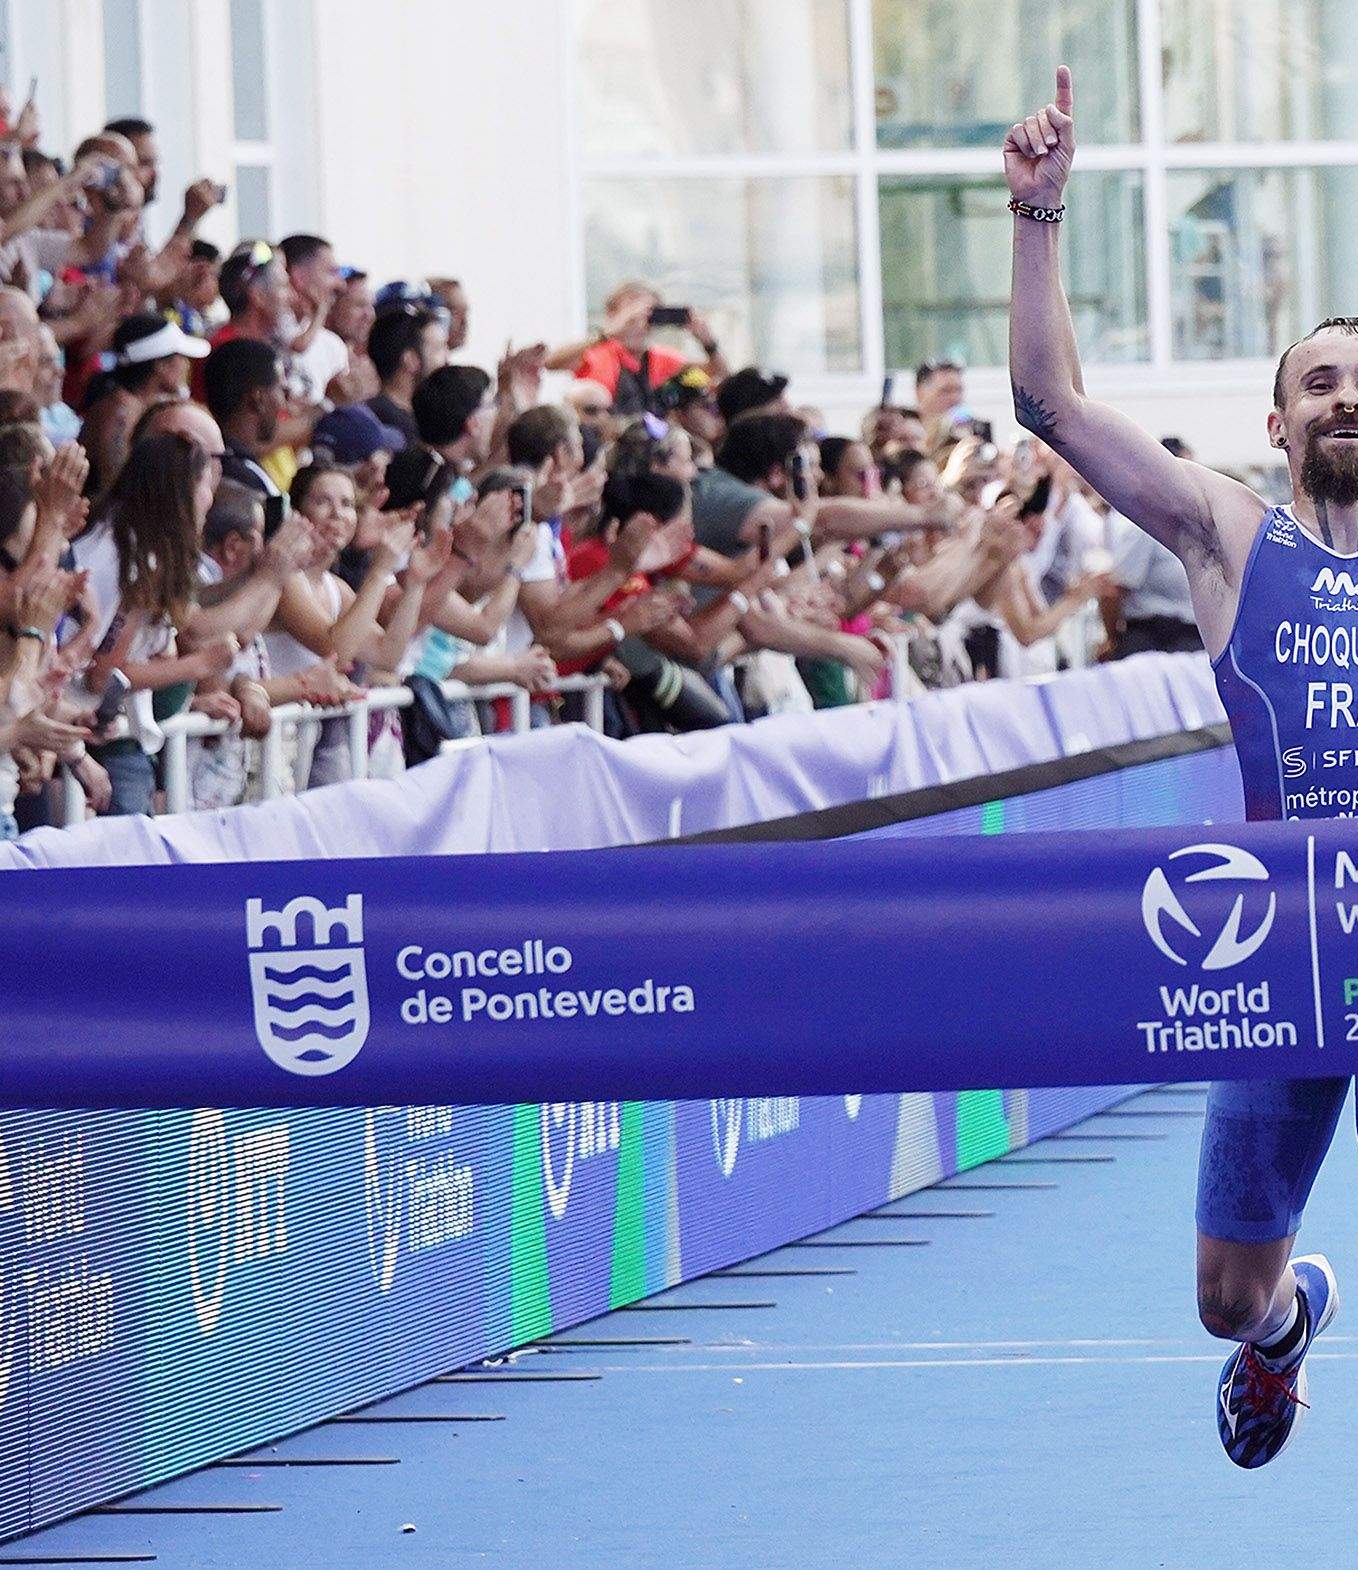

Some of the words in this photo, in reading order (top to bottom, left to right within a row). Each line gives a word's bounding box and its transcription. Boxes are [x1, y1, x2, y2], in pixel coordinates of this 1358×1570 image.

[1266, 532, 1298, 549] Triathlon
[396, 939, 573, 980] Concello
[400, 989, 453, 1025] de
[462, 979, 696, 1022] Pontevedra
[1159, 980, 1270, 1017] World
[1136, 1018, 1298, 1053] Triathlon
[22, 1127, 85, 1246] World
[233, 1123, 290, 1264] NTT
[23, 1251, 114, 1374] Triathlon
